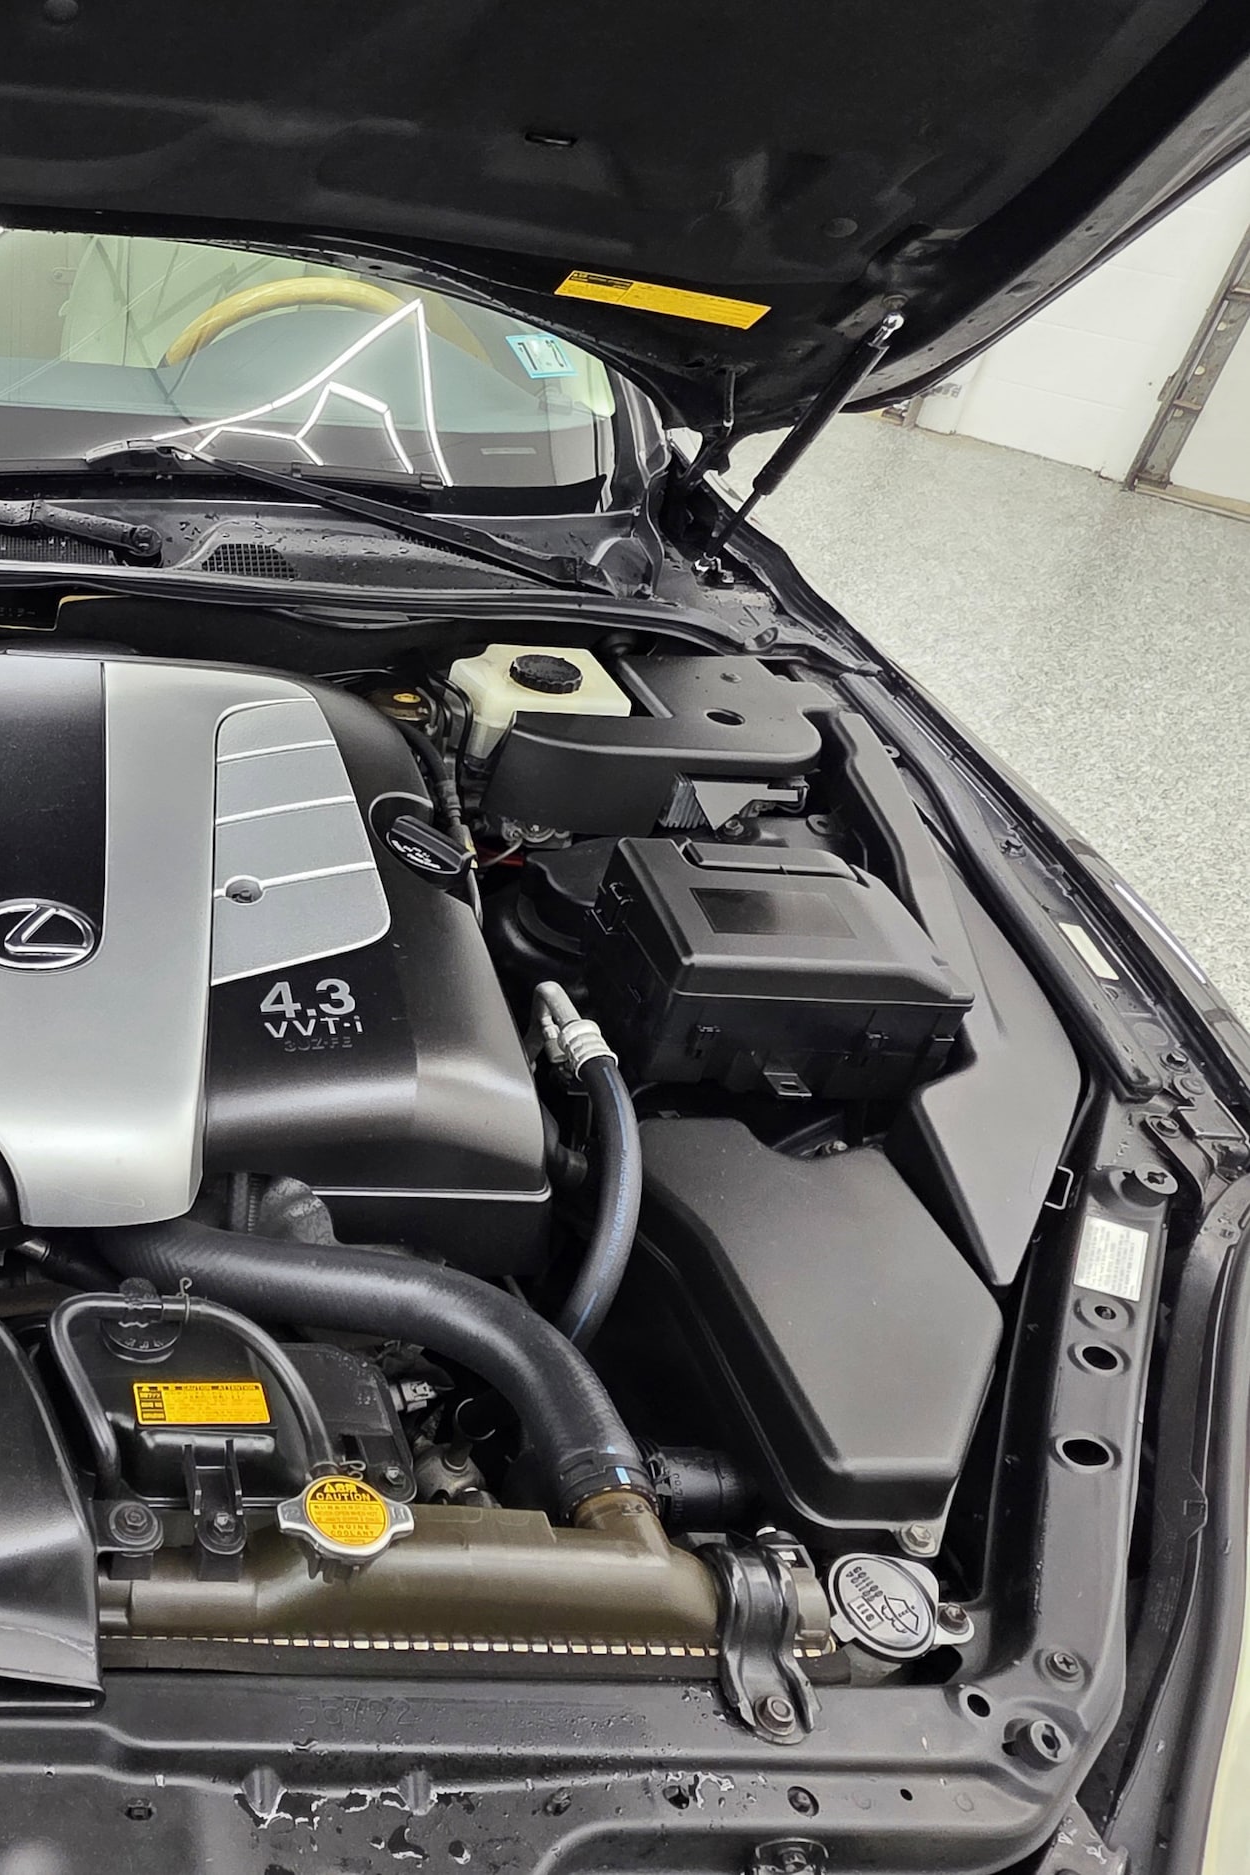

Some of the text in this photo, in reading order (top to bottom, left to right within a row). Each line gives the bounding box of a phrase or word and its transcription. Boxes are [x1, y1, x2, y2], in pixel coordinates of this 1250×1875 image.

[259, 978, 356, 1018] 4.3
[264, 1015, 363, 1038] VVT-i
[316, 1492, 371, 1502] CAUTION
